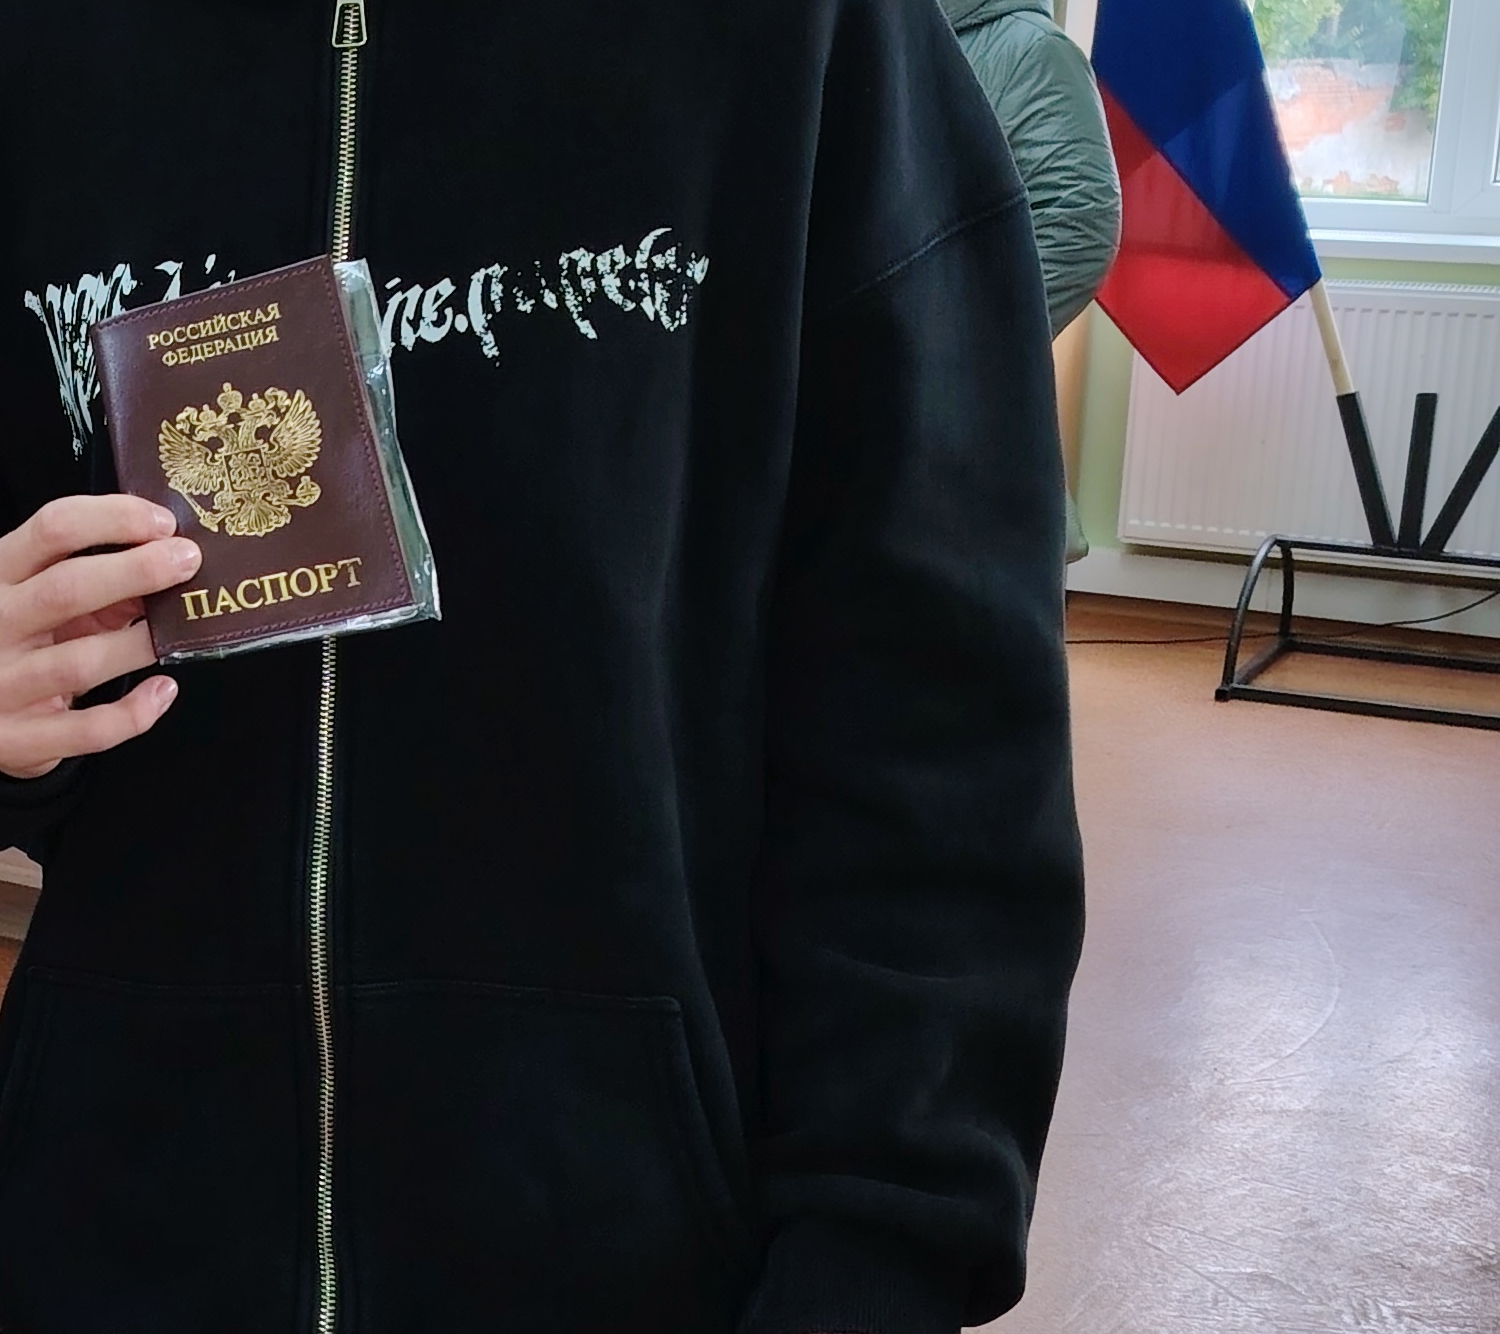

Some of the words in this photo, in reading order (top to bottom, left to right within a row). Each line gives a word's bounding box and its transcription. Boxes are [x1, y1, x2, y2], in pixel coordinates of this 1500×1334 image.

[147, 302, 282, 351] РОССИЙСКАЯ
[161, 325, 280, 367] ФЕДЕРАЦИЯ
[180, 557, 363, 621] ПАСПОРТ
